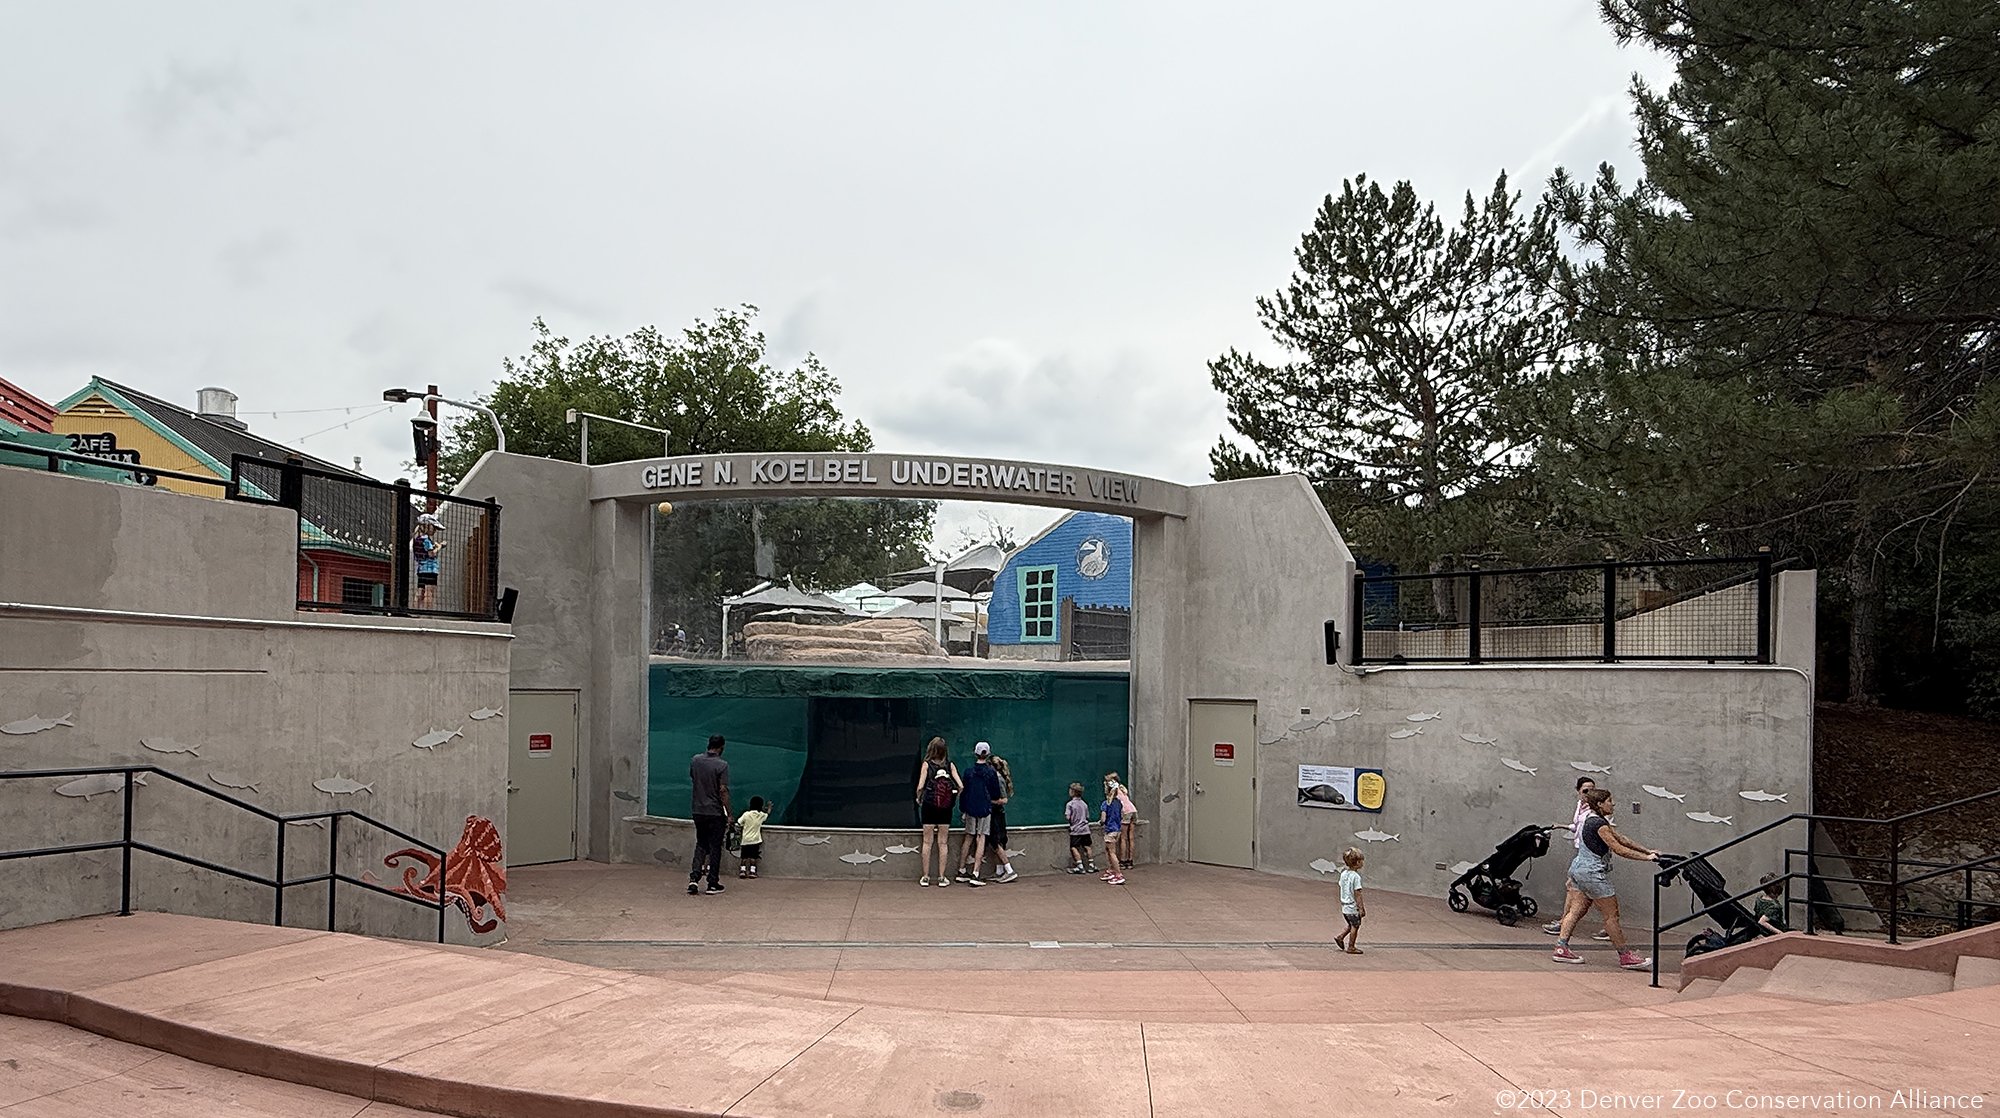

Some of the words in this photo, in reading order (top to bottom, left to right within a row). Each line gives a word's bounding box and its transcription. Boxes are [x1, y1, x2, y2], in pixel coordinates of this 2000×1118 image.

[641, 461, 702, 489] GENE
[713, 460, 738, 484] N.
[750, 458, 878, 484] KOELBEL
[891, 460, 1076, 496] UNDERWATER
[1086, 473, 1142, 503] VIEW
